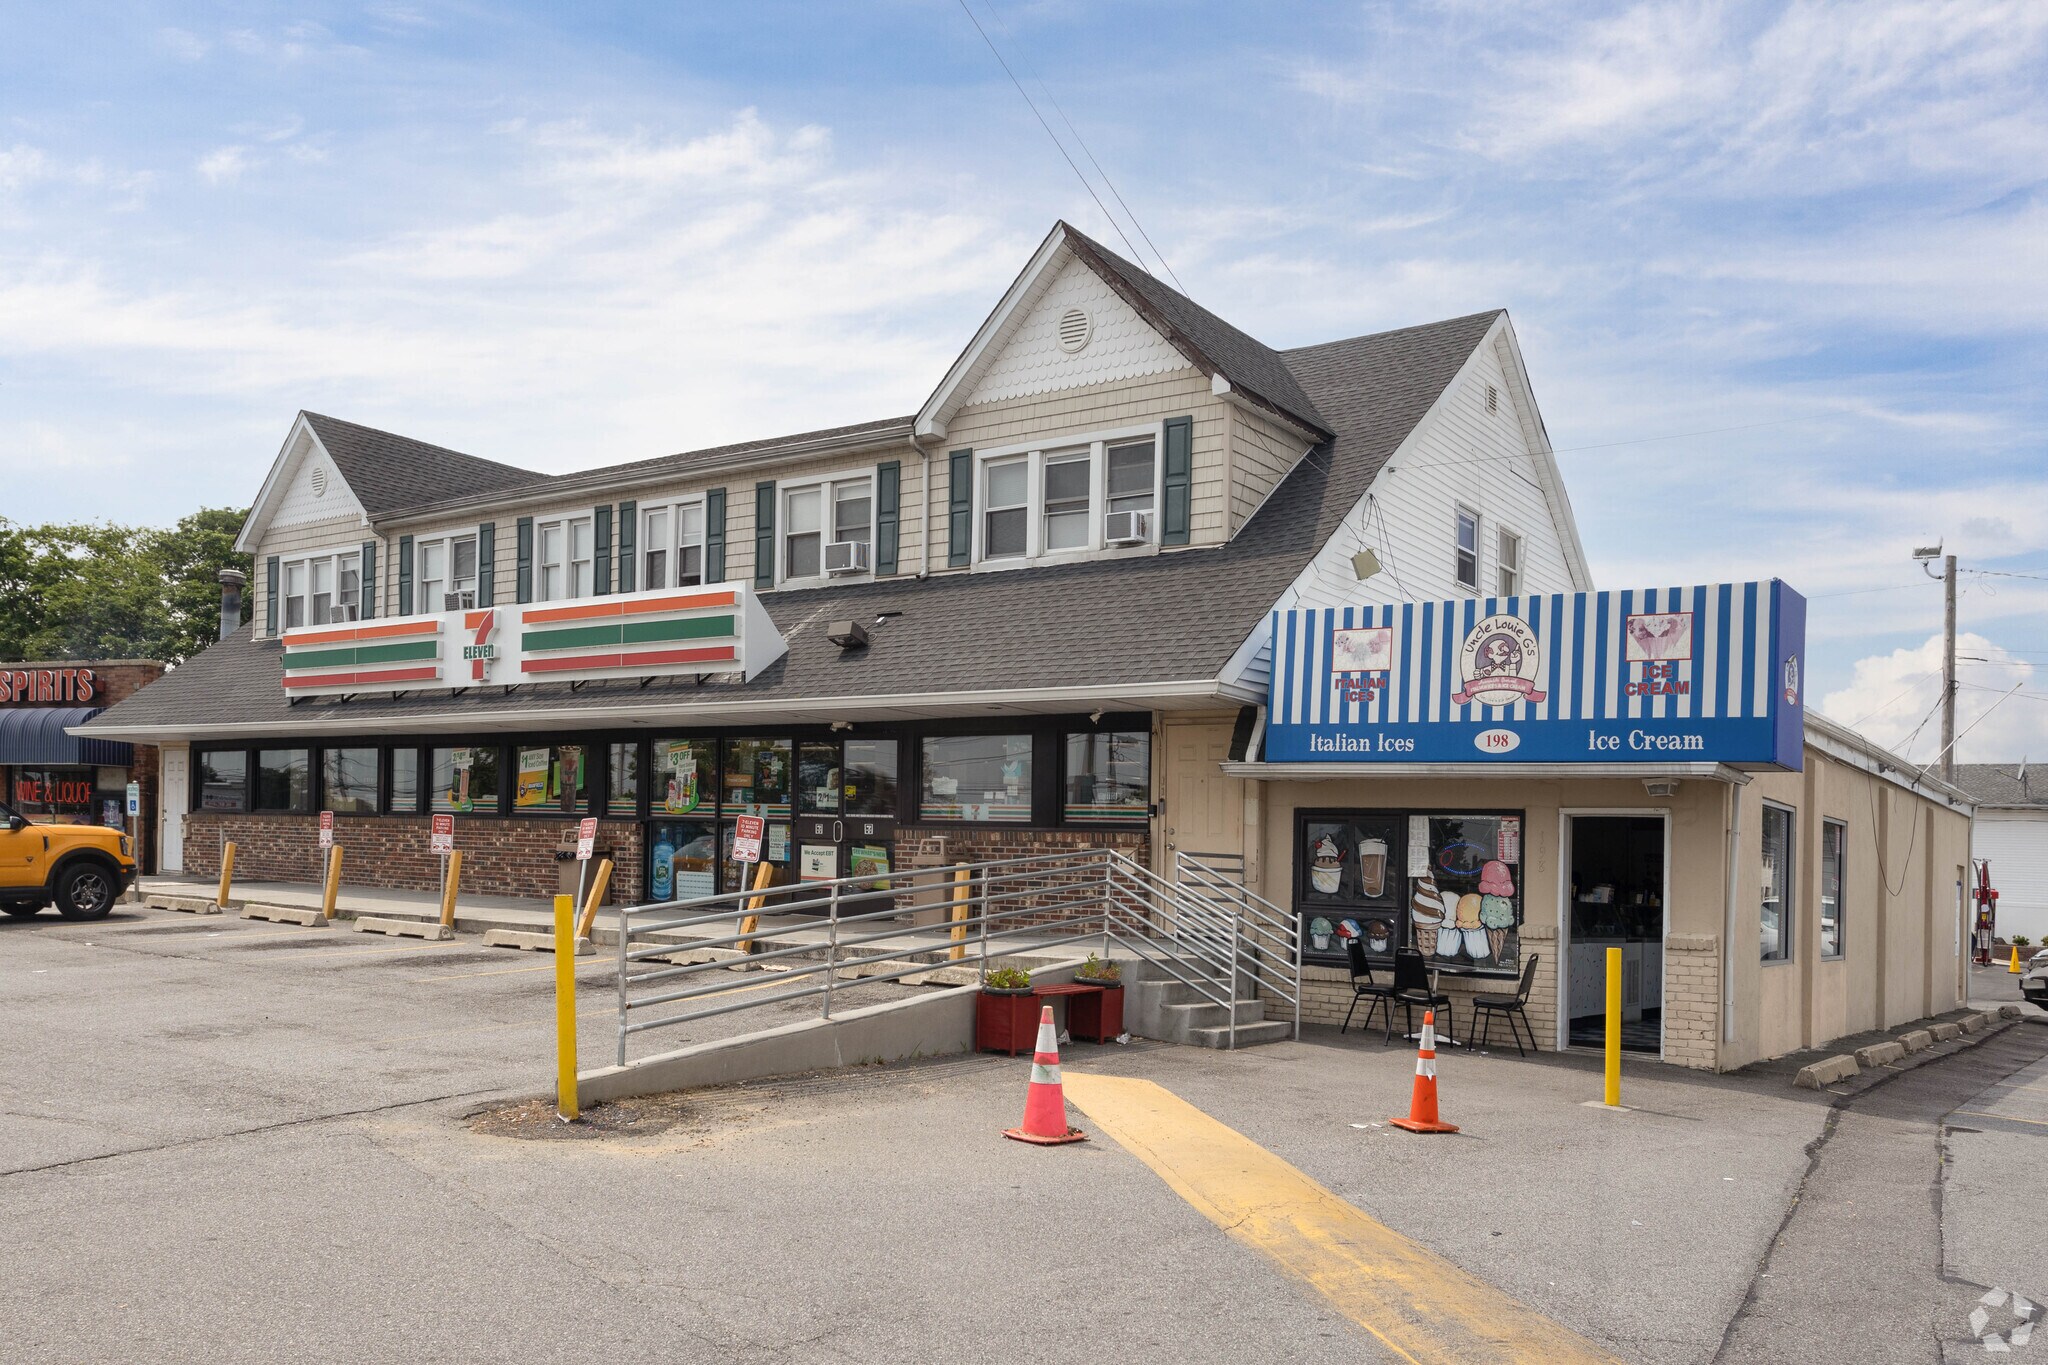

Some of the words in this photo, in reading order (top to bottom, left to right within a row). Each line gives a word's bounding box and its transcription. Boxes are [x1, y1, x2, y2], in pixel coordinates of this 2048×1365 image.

[465, 609, 494, 680] 7
[1465, 623, 1492, 653] Uncle
[1495, 618, 1524, 638] Louie
[1522, 638, 1535, 656] G's
[1642, 665, 1673, 679] ICE
[0, 669, 94, 702] SPIRITS
[1335, 678, 1387, 690] ITALIAN
[1624, 681, 1690, 696] CREAM
[1345, 691, 1375, 702] ICES
[1310, 733, 1371, 752] Italian
[1377, 733, 1415, 752] Ices
[1486, 734, 1509, 747] 198
[1588, 730, 1620, 750] Ice
[1628, 730, 1705, 750] Cream
[679, 750, 691, 760] OFF
[15, 781, 42, 802] WINE
[44, 782, 53, 802] &
